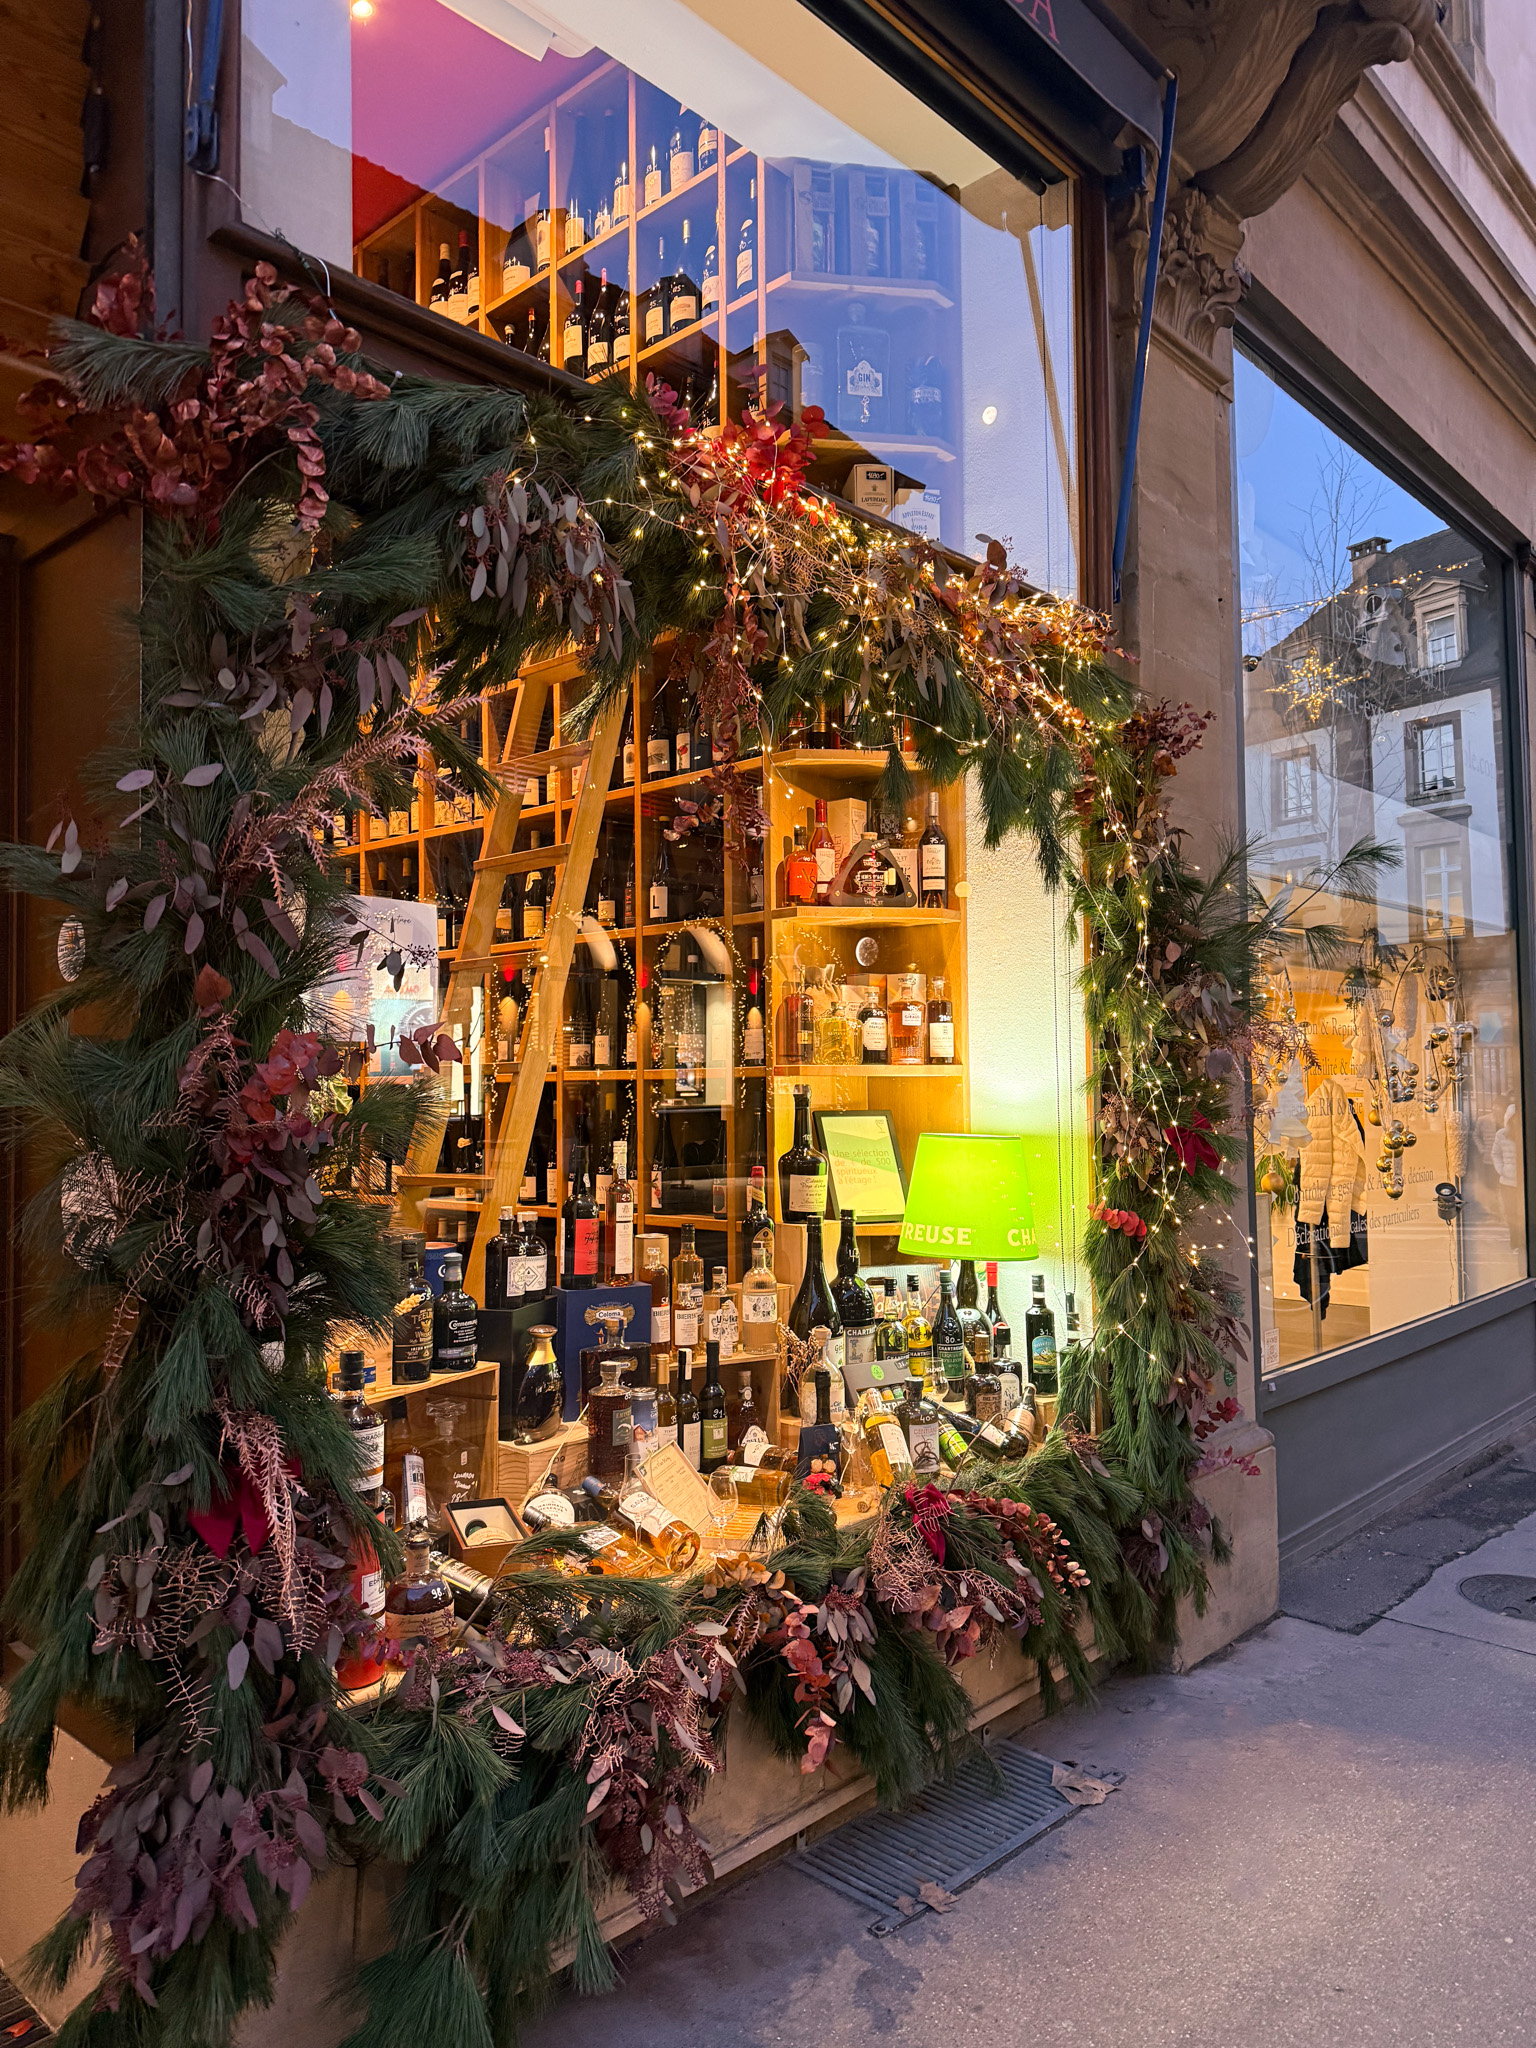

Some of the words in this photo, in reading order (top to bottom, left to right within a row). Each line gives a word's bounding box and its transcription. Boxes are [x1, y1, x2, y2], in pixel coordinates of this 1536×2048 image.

[858, 373, 871, 383] GIN
[902, 511, 921, 519] APPLETON
[921, 511, 935, 520] ESTATE
[1321, 1018, 1329, 1035] &
[1340, 1058, 1349, 1076] &
[1320, 1098, 1334, 1116] RH
[1337, 1098, 1345, 1115] &
[832, 1150, 849, 1158] Une
[852, 1149, 890, 1158] sélection
[834, 1159, 846, 1167] de
[860, 1158, 872, 1166] de
[876, 1157, 891, 1166] 500
[836, 1168, 878, 1177] spiritueux
[1407, 1166, 1434, 1185] décision
[844, 1175, 872, 1186] l'étage
[1367, 1173, 1376, 1191] &
[1287, 1222, 1339, 1247] Déclarations
[1369, 1212, 1381, 1230] des
[1382, 1204, 1420, 1232] particuliers
[598, 1310, 621, 1318] Coloma
